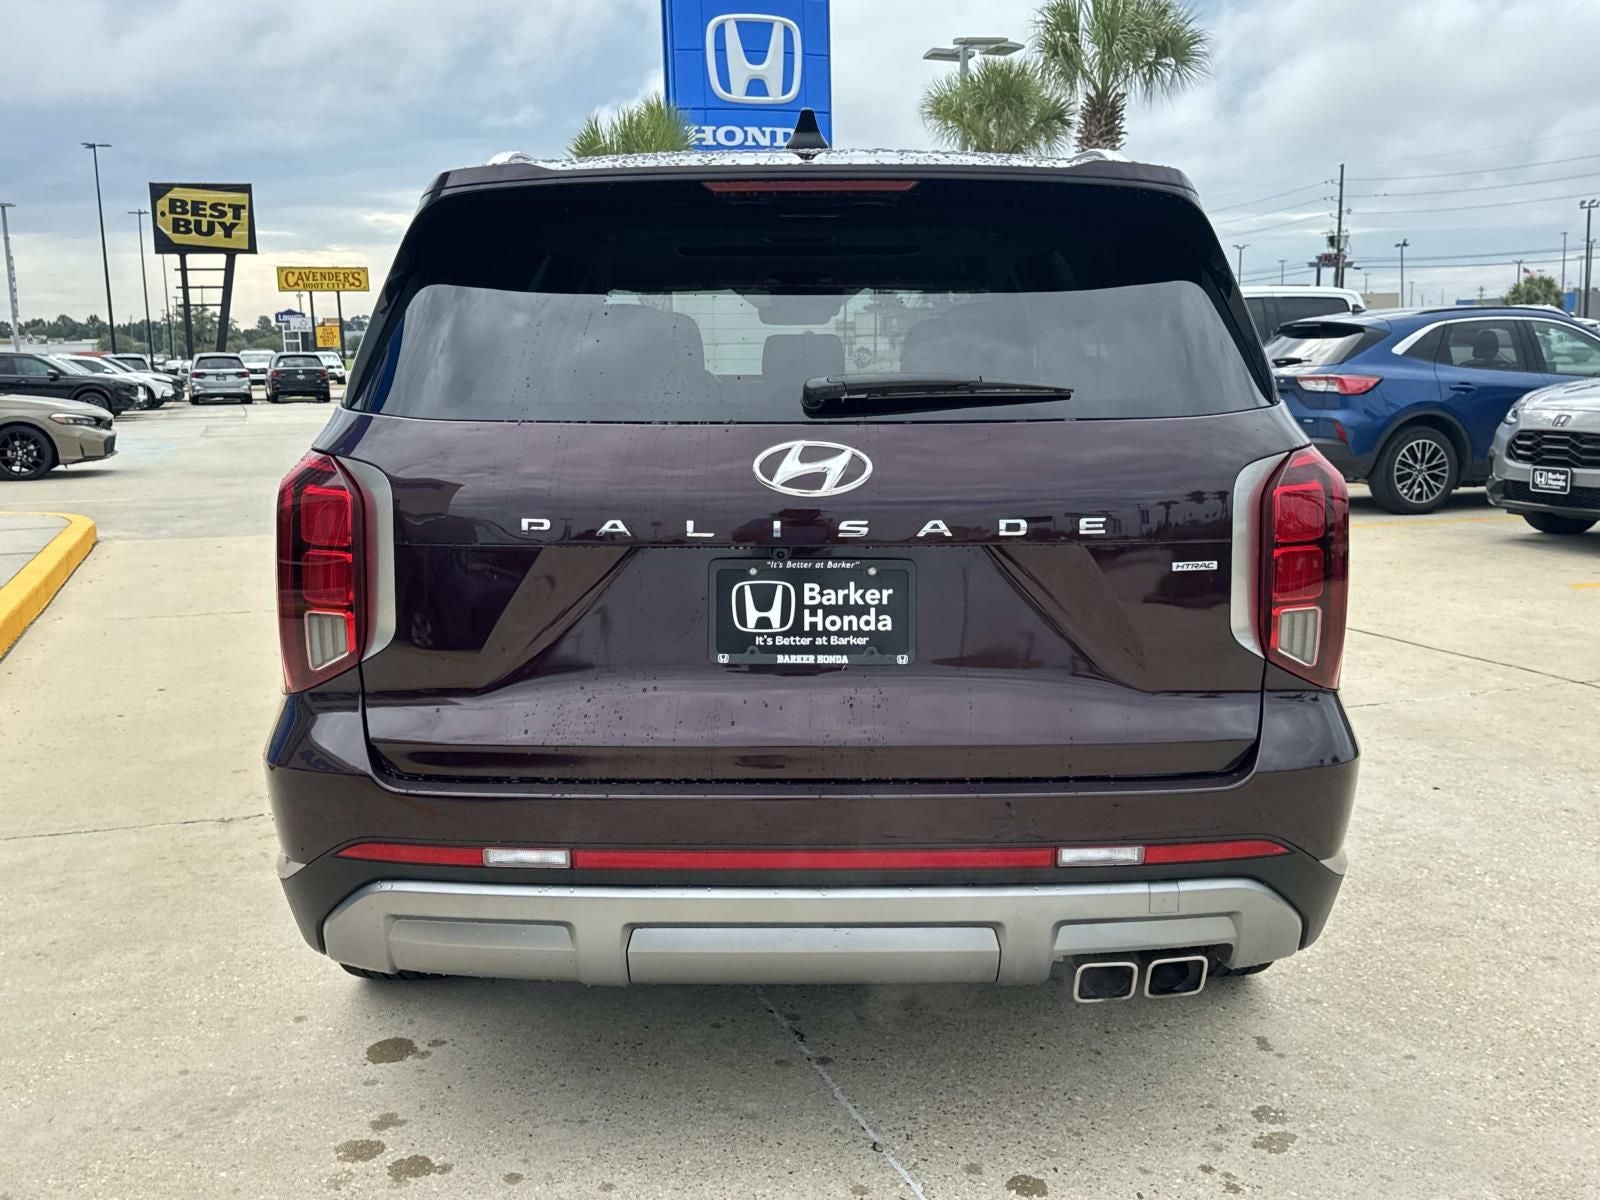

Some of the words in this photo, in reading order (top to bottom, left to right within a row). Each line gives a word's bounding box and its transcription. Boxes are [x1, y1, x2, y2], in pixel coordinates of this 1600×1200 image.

[684, 125, 796, 147] HOND
[168, 198, 246, 220] BEST
[172, 217, 240, 239] BUY
[284, 270, 362, 288] CAVENDER'S
[521, 517, 1108, 538] PALISADE
[786, 561, 812, 569] Better
[804, 581, 893, 605] Barker
[804, 607, 892, 631] Honda
[755, 635, 773, 645] It's
[775, 636, 812, 645] Better
[815, 637, 828, 645] at
[830, 635, 869, 645] Barker
[777, 655, 814, 663] BARKER
[817, 655, 848, 663] HONDA
